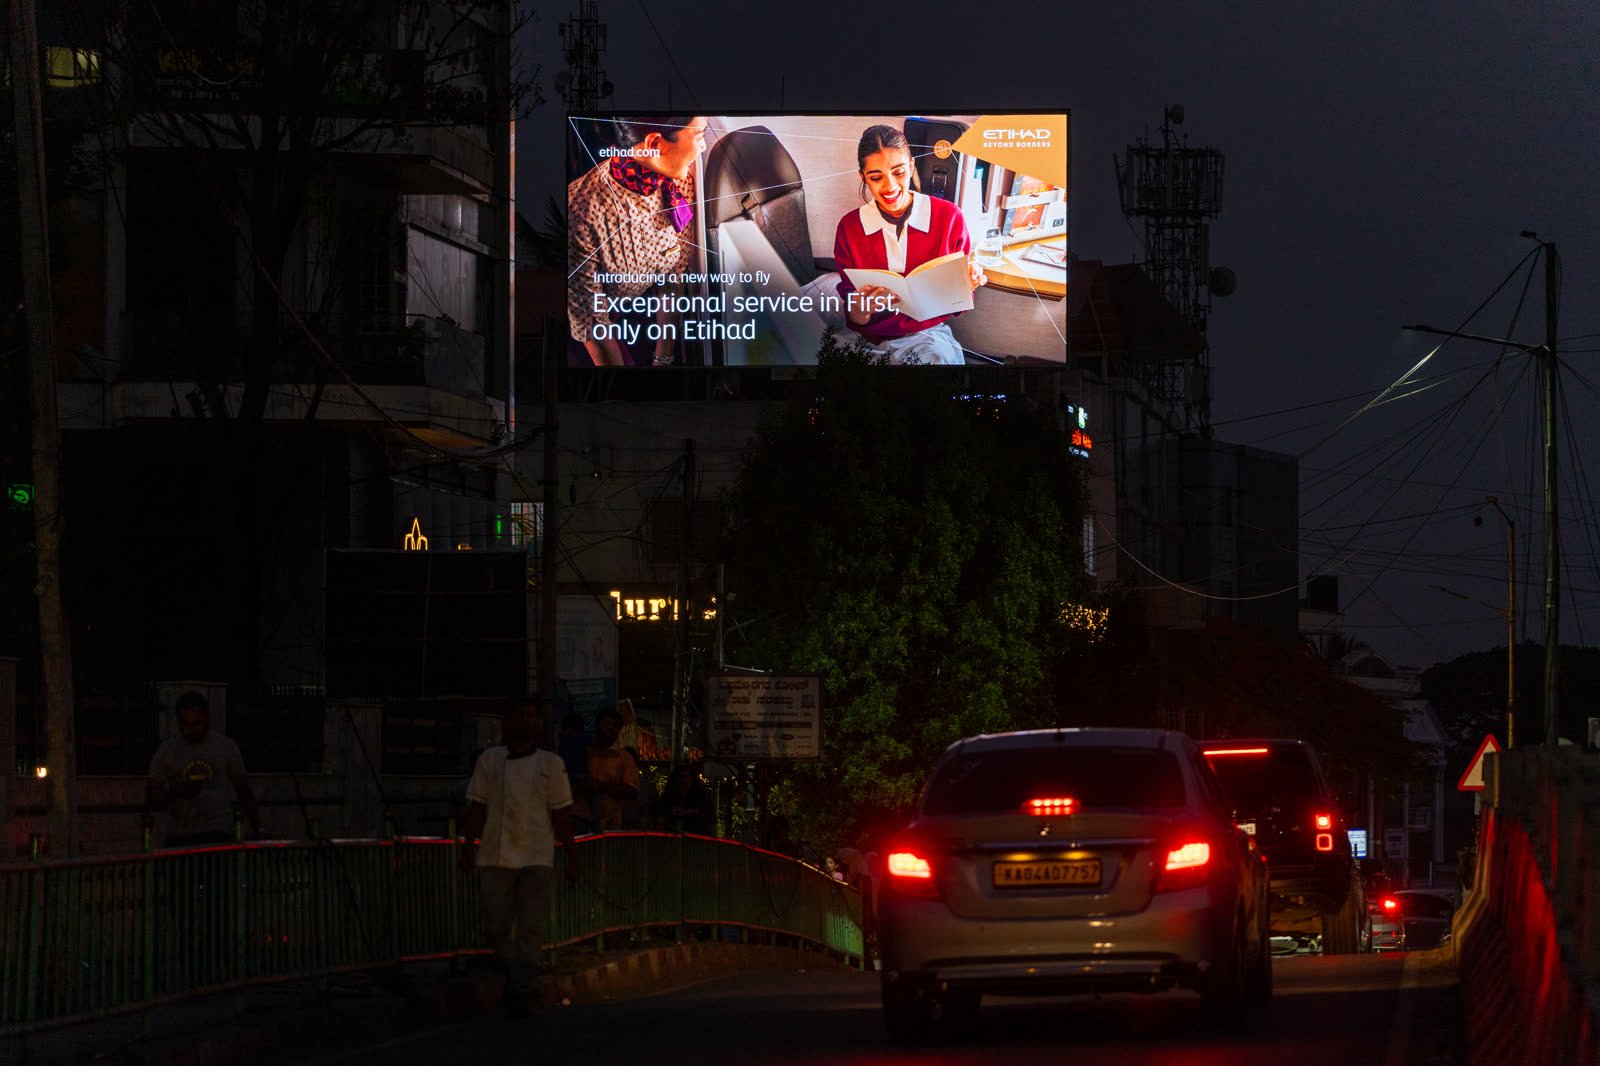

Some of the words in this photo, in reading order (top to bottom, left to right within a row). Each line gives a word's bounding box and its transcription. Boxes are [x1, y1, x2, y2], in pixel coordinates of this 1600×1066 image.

[983, 129, 1051, 139] ETIHAD
[599, 146, 660, 158] etihad.com
[593, 270, 665, 286] Introducing
[669, 274, 678, 283] a
[681, 274, 708, 283] new
[710, 274, 736, 286] way
[739, 272, 753, 283] to
[756, 270, 771, 286] fly
[593, 292, 726, 316] Exceptional
[733, 293, 813, 313] service
[820, 293, 840, 312] in
[848, 292, 900, 315] First,
[593, 319, 641, 345] only
[647, 324, 676, 340] on
[684, 319, 756, 340] Etihad
